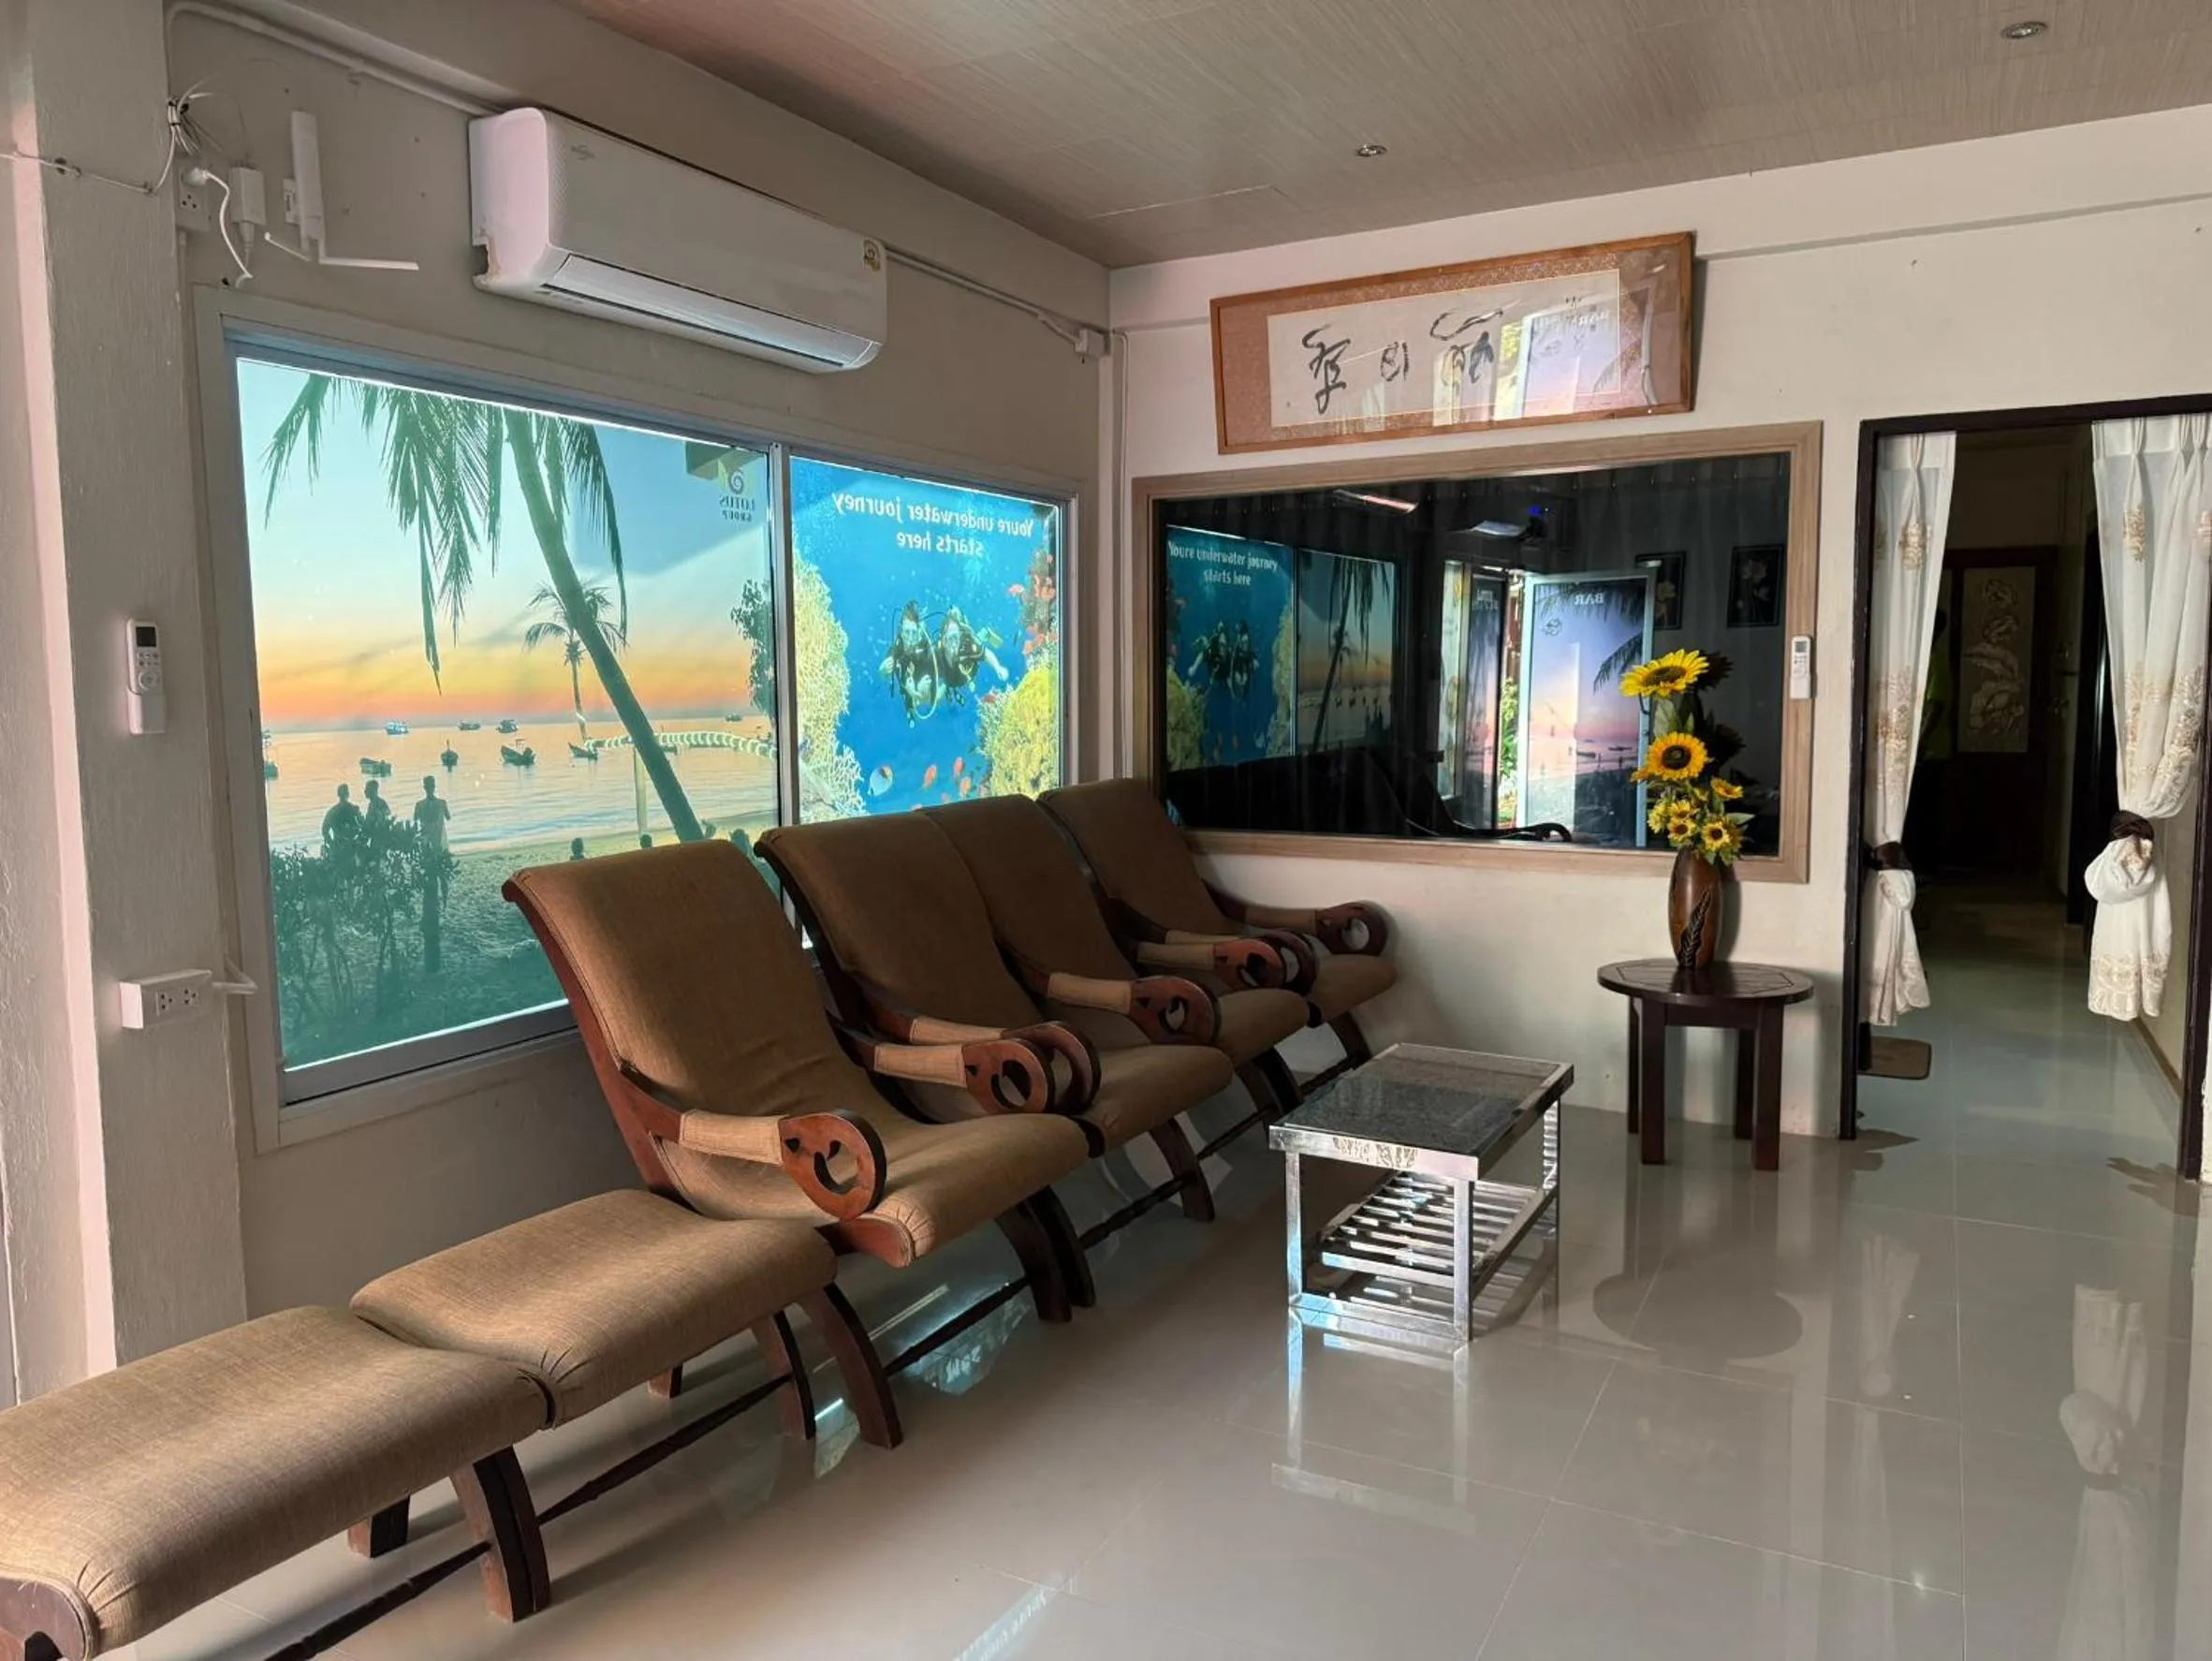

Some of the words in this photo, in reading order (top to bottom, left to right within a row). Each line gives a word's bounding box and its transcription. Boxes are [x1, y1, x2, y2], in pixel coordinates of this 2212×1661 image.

[1167, 540, 1194, 558] Youre
[1196, 547, 1246, 566] underwater
[1247, 552, 1278, 572] journey
[1204, 568, 1232, 584] starts
[1233, 570, 1252, 585] here
